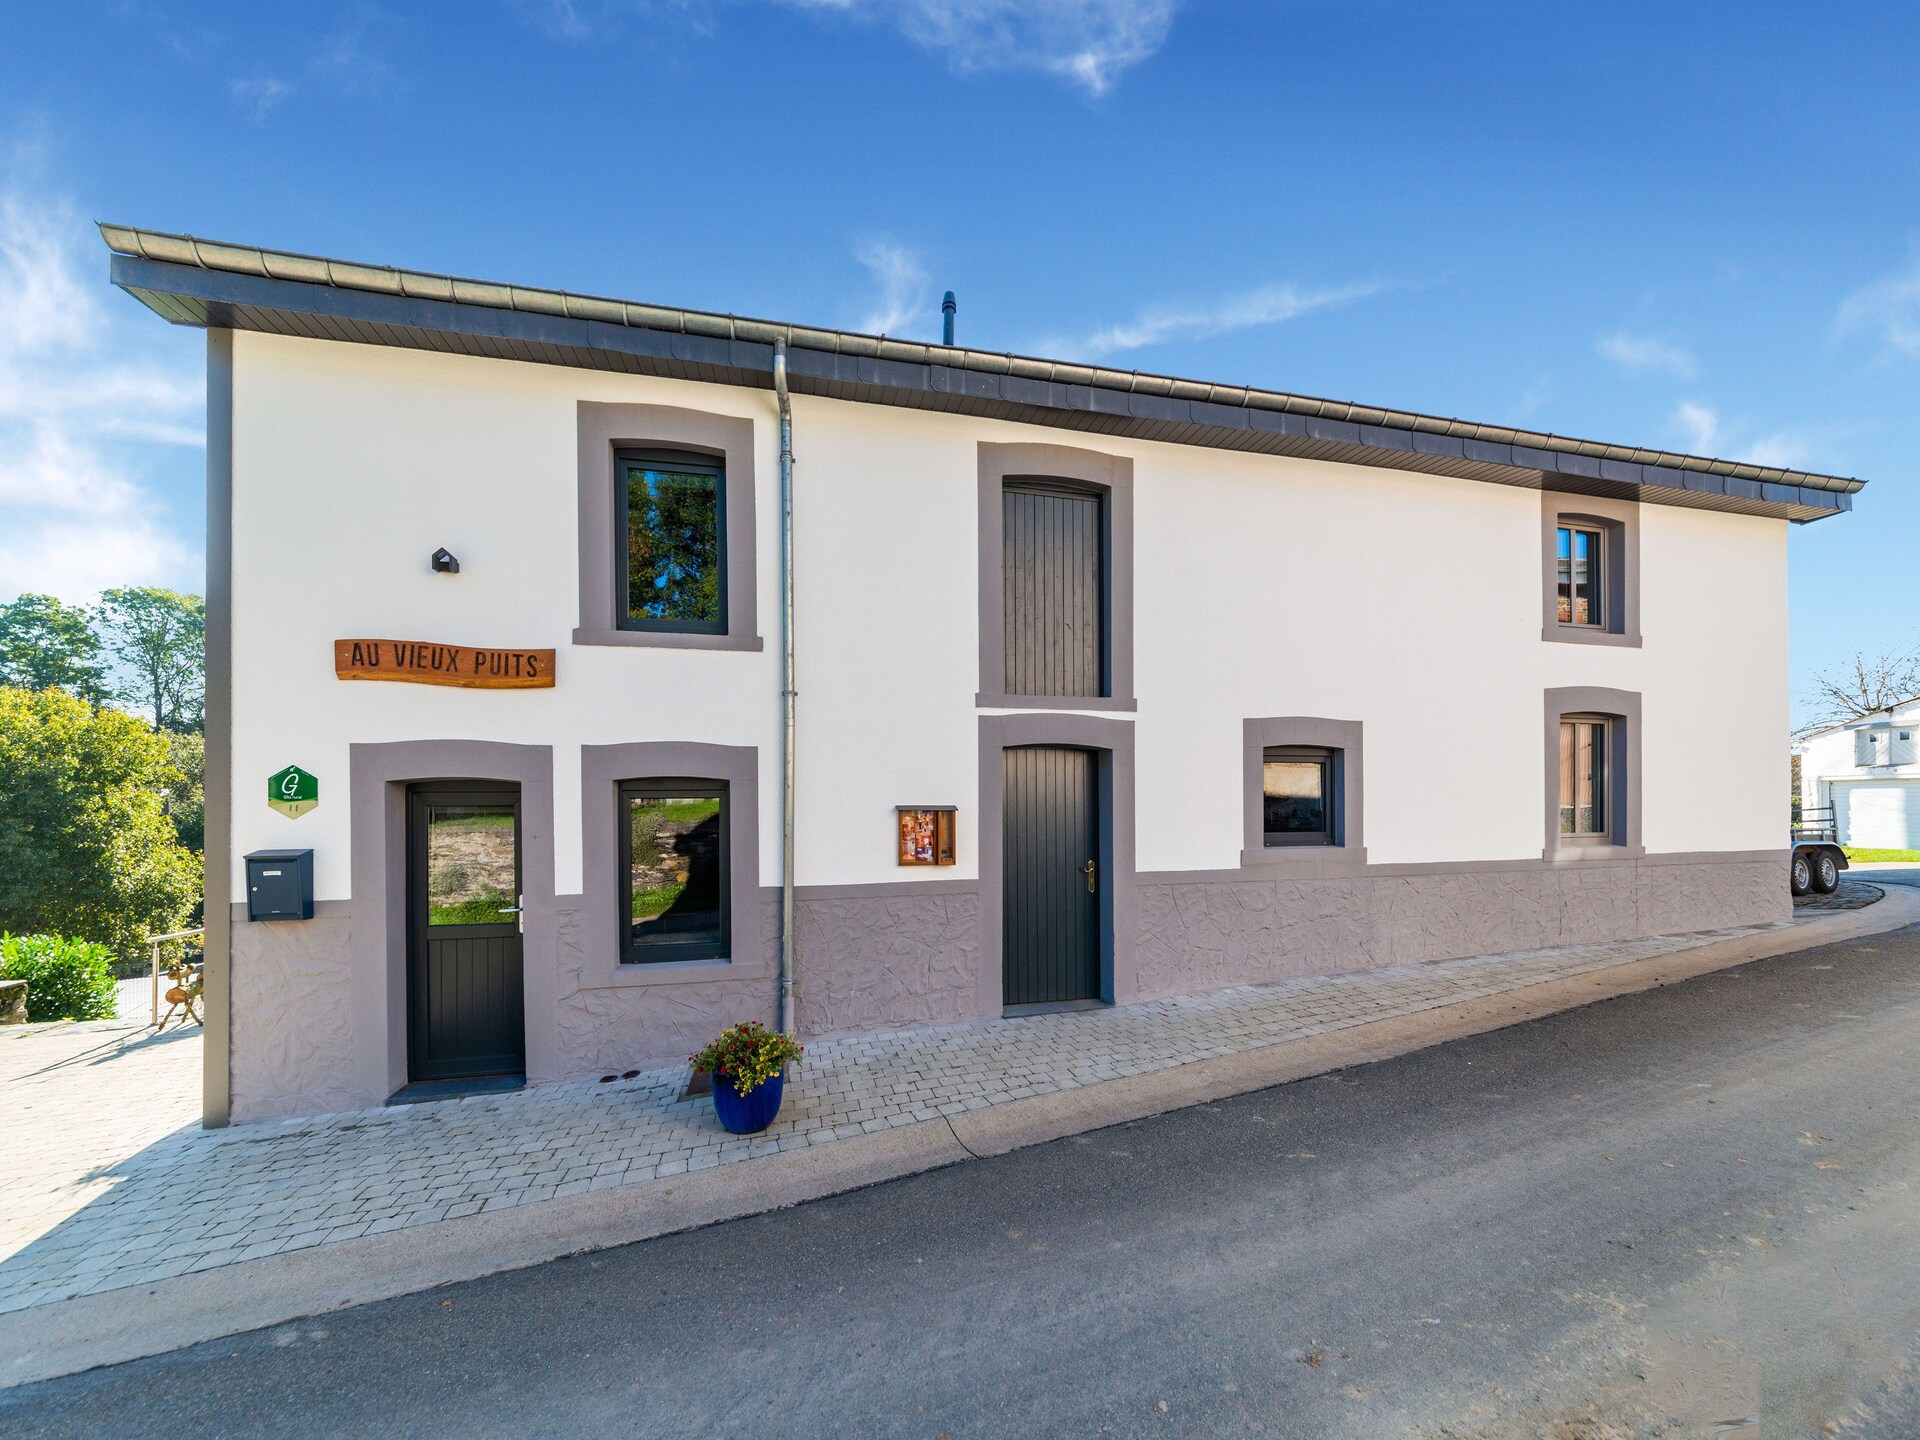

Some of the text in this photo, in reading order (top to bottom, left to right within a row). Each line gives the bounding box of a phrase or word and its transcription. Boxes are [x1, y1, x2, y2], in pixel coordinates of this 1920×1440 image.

[351, 642, 538, 678] AU VIEUX PUITS
[281, 773, 299, 796] G
